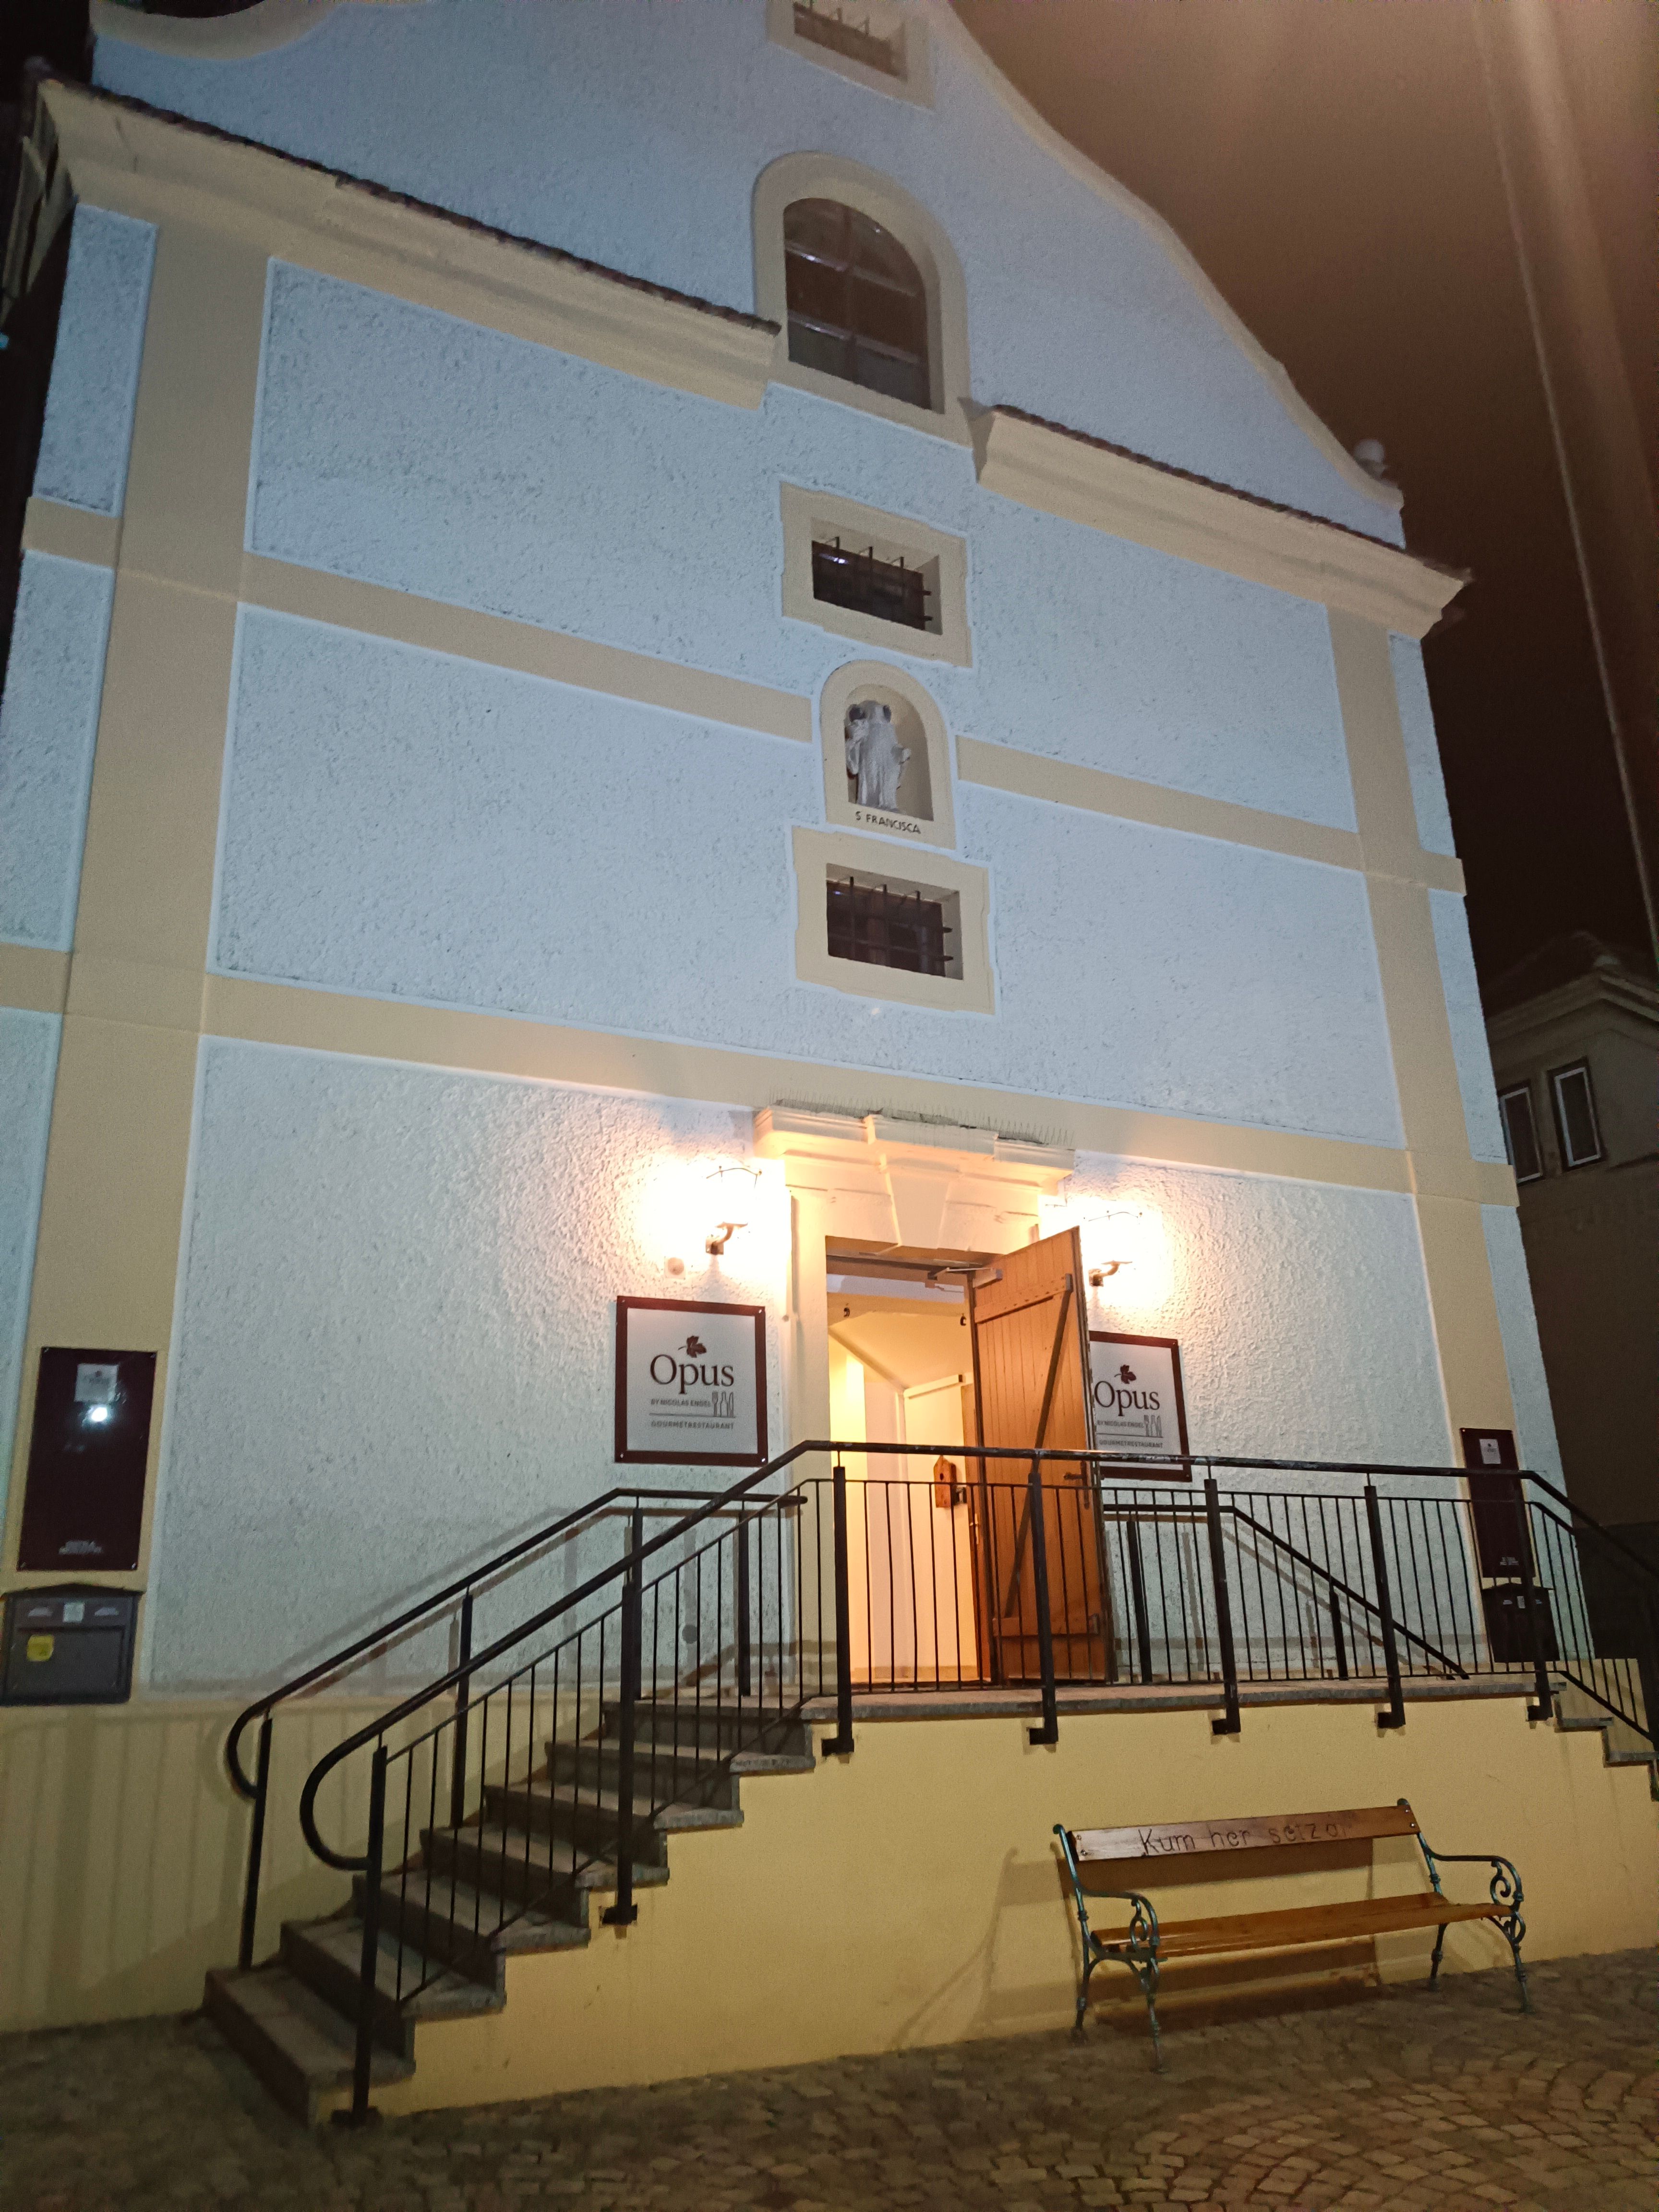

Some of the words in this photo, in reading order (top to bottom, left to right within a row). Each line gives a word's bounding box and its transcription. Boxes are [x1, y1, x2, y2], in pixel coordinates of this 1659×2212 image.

[855, 811, 861, 821] S
[866, 814, 921, 834] FRANCISCA
[649, 1354, 734, 1395] Opus
[1094, 1380, 1160, 1417] Opus
